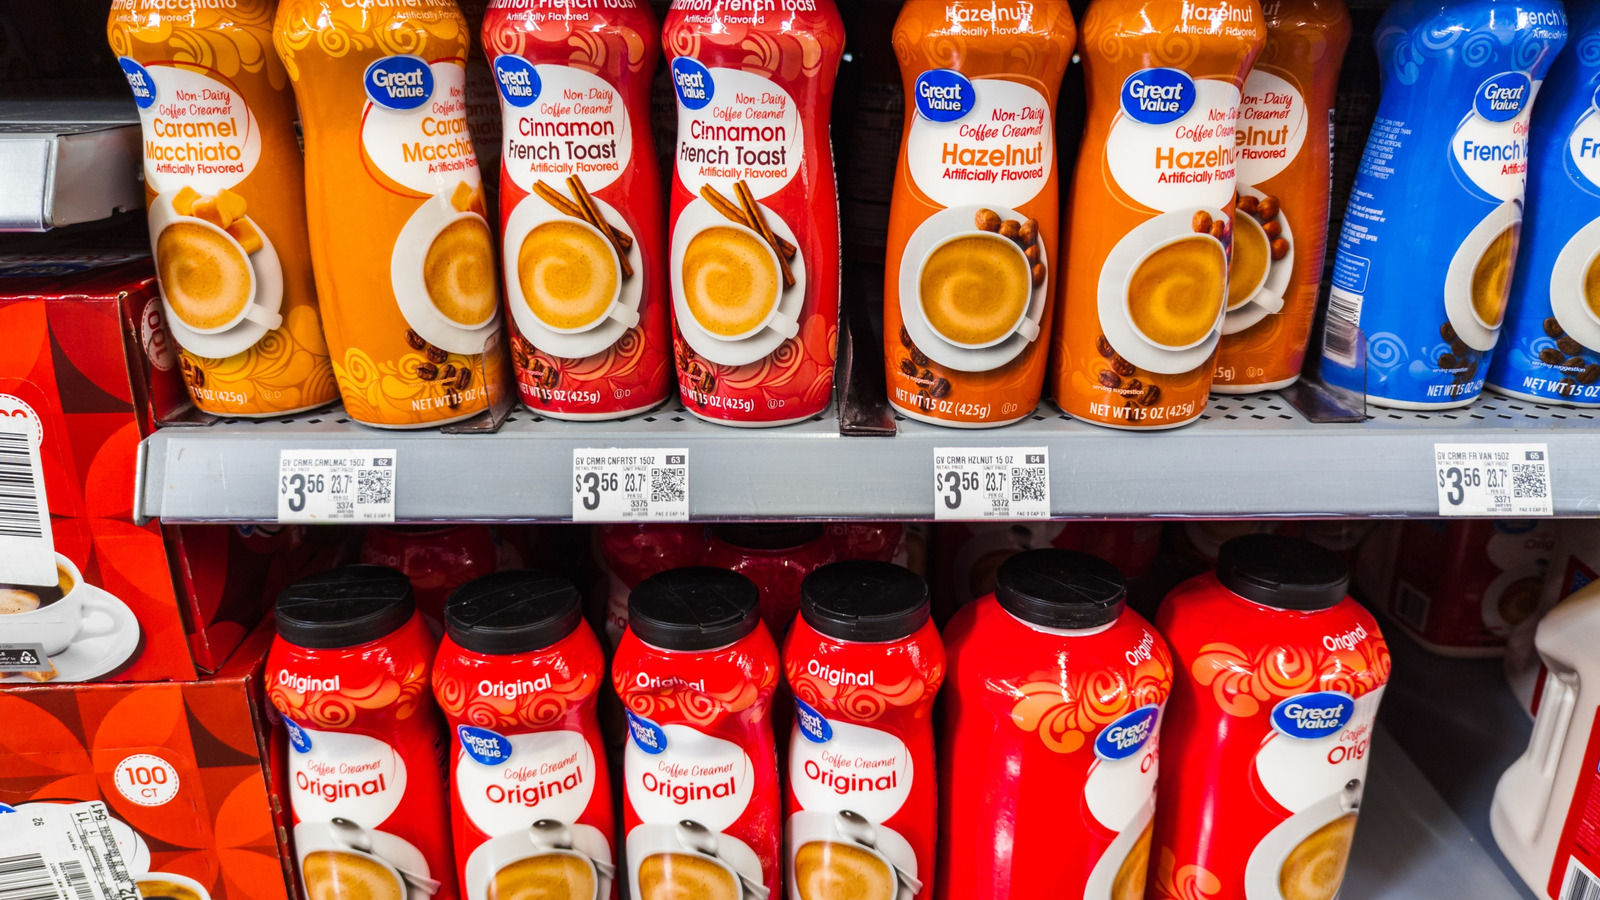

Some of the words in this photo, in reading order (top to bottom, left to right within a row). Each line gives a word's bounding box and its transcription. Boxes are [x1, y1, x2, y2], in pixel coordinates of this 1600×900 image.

[396, 11, 438, 20] Artificially
[548, 12, 589, 21] Flavored
[723, 15, 765, 25] Flavored
[945, 5, 1029, 23] Hazelnut
[1180, 2, 1252, 22] Hazelnut
[372, 68, 424, 88] Great
[497, 67, 531, 86] Great
[674, 68, 704, 88] Great
[176, 89, 231, 105] Non-Dairy
[386, 85, 425, 98] Value
[506, 83, 533, 98] Value
[563, 88, 614, 104] Non-Dairy
[682, 86, 706, 100] Value
[919, 80, 962, 100] Great
[1129, 79, 1184, 101] Great
[1484, 83, 1524, 101] Great
[736, 92, 786, 110] Non-Dairy
[927, 98, 962, 111] Value
[1139, 98, 1179, 112] Value
[1490, 98, 1519, 111] Value
[159, 105, 187, 119] Coffee
[189, 105, 232, 116] Creamer
[541, 103, 571, 118] Coffee
[573, 103, 614, 115] Creamer
[713, 106, 744, 122] Coffee
[745, 107, 786, 120] Creamer
[991, 106, 1045, 125] Non-Dairy
[1244, 107, 1291, 121] Creamer
[154, 118, 238, 138] Caramel
[518, 117, 615, 137] Cinnamon
[691, 120, 786, 142] Cinnamon
[959, 124, 998, 141] Coffee
[1002, 124, 1043, 138] Creamer
[1175, 124, 1213, 142] Coffee
[146, 141, 241, 162] Macchiato
[509, 139, 560, 161] French
[565, 140, 617, 160] Toast
[680, 142, 729, 164] French
[735, 145, 787, 166] Toast
[941, 142, 1043, 167] Hazelnut
[1241, 147, 1286, 160] Flavored
[1463, 140, 1520, 161] French
[156, 163, 195, 176] Artificially
[197, 163, 244, 173] Flavored
[428, 159, 465, 174] Artificially
[530, 161, 573, 175] Artificially
[576, 160, 619, 172] Flavored
[698, 166, 741, 181] Artificially
[744, 167, 788, 178] Flavored
[942, 168, 998, 184] Artificially
[1001, 167, 1043, 181] Flavored
[1157, 169, 1212, 185] Artificially
[1531, 360, 1552, 369] serving
[1553, 363, 1586, 373] suggestion
[910, 376, 935, 386] suggestion
[1523, 376, 1546, 391] NET
[1547, 381, 1567, 395] WT
[1568, 384, 1585, 397] 15
[1584, 386, 1600, 398] OZ
[203, 390, 215, 401] OZ
[215, 390, 248, 405] (425g)
[411, 397, 432, 411] NET
[434, 393, 451, 408] WT
[452, 391, 463, 405] 15
[465, 387, 477, 402] OZ
[529, 385, 541, 398] WT
[541, 388, 553, 401] 15
[553, 390, 566, 401] OZ
[567, 390, 601, 405] (425g)
[1112, 387, 1144, 397] suggestion
[1427, 384, 1443, 397] NET
[1443, 384, 1456, 397] WT
[687, 387, 697, 400] WT
[698, 392, 708, 405] 15
[709, 395, 721, 408] OZ
[722, 397, 755, 413] (425g)
[895, 387, 908, 401] NET
[909, 392, 922, 407] WT
[924, 396, 937, 411] 15
[939, 400, 953, 414] OZ
[954, 402, 991, 419] (425g)
[1089, 402, 1111, 418] NET
[1112, 406, 1131, 420] WT
[1133, 407, 1147, 420] 15
[1150, 406, 1164, 420] OZ
[1165, 399, 1195, 421] (425g)
[283, 459, 291, 467] GV
[294, 459, 313, 467] CRMR
[315, 459, 348, 467] CRMLMAC
[377, 458, 388, 466] 62
[576, 457, 584, 466] GV
[586, 457, 606, 465] CRMR
[608, 456, 637, 465] CNFRTST
[671, 456, 681, 464] 63
[936, 456, 945, 464] GV
[947, 456, 966, 464] CRMR
[968, 456, 993, 464] HZLNUT
[996, 456, 1003, 464] 15
[1005, 456, 1013, 464] OZ
[1437, 452, 1445, 460] GV
[1448, 452, 1466, 460] CRMR
[1469, 452, 1477, 460] FR
[1479, 452, 1492, 460] VAN
[336, 501, 354, 510] 3374
[992, 499, 1009, 507] 3372
[1322, 622, 1368, 652] Original
[279, 669, 340, 693] Original
[807, 659, 874, 687] Original
[478, 673, 552, 700] Original
[636, 671, 706, 693] Original
[1283, 703, 1345, 720] Great
[1106, 714, 1153, 744] Great
[1296, 716, 1339, 730] Value
[461, 729, 500, 750] Great
[1116, 729, 1148, 751] Value
[471, 743, 501, 758] Value
[307, 759, 336, 776] Coffee
[339, 759, 383, 774] Creamer
[504, 766, 537, 782] Coffee
[540, 751, 578, 775] Creamer
[658, 759, 689, 778] Coffee
[691, 761, 734, 777] Creamer
[821, 750, 852, 769] Coffee
[854, 755, 897, 770] Creamer
[125, 766, 168, 787] 100
[804, 759, 897, 796] Original
[141, 788, 158, 798] CT
[296, 771, 386, 803] Original
[486, 765, 583, 808] Original
[642, 771, 736, 805] Original
[75, 811, 90, 824] 11
[90, 803, 108, 821] 541
[32, 816, 45, 828] 92
